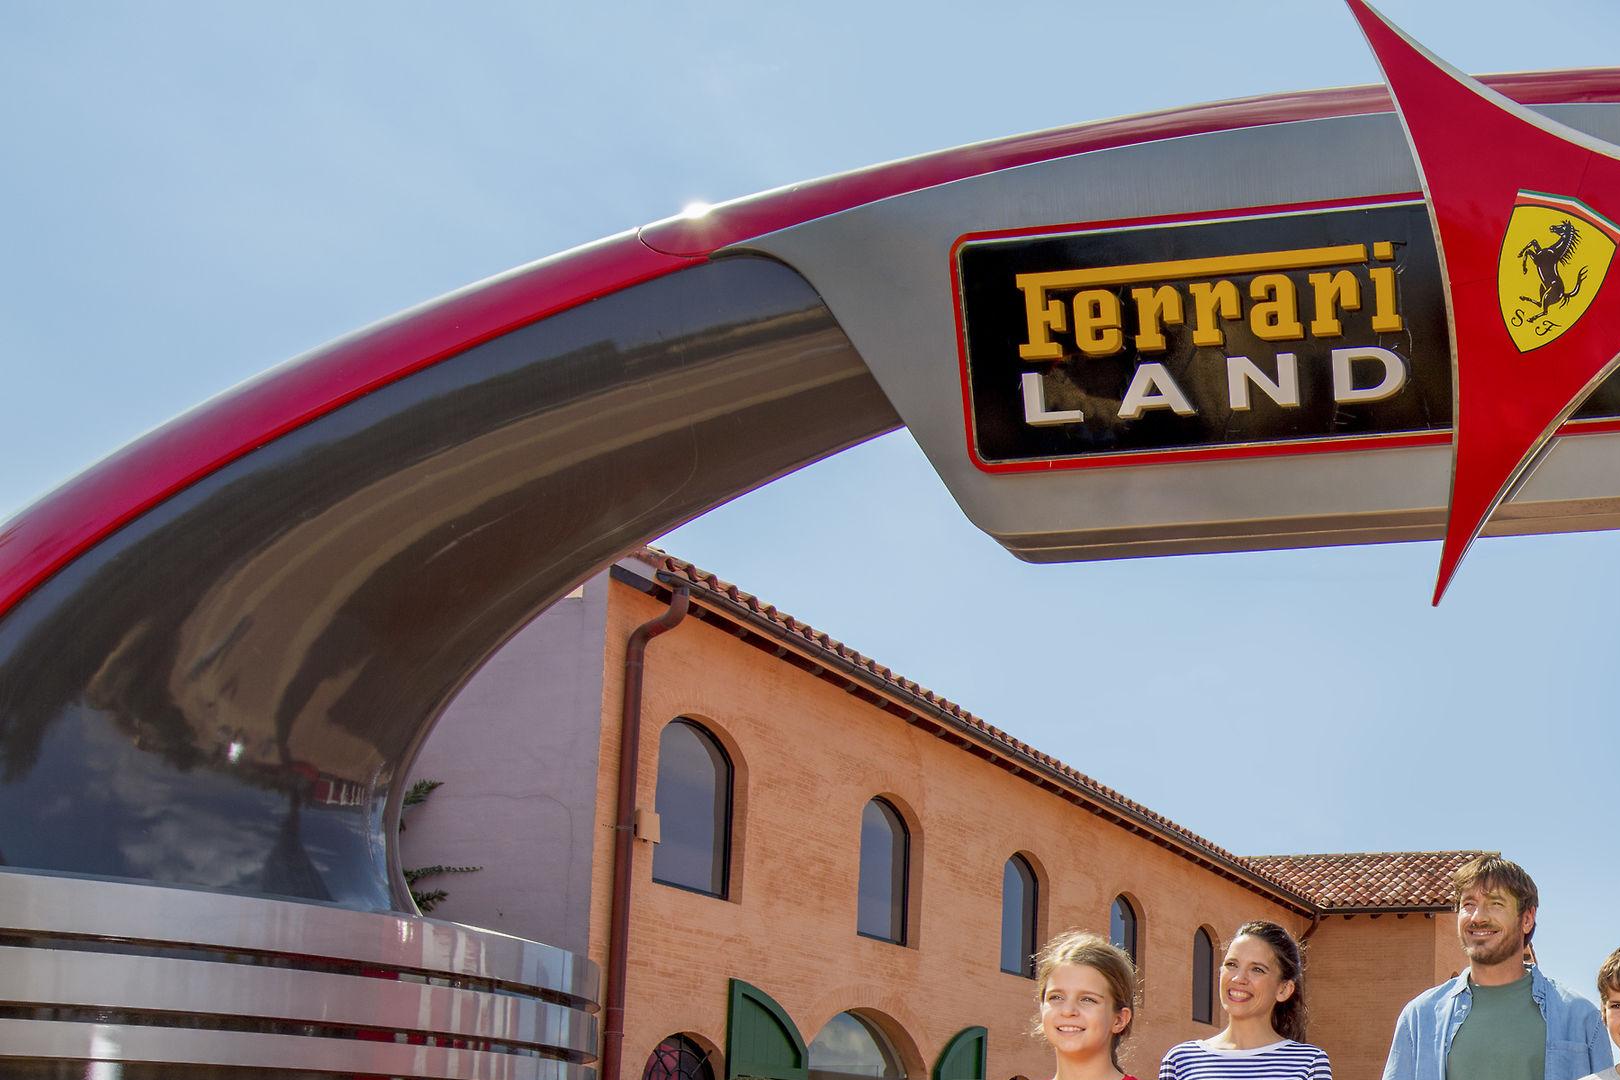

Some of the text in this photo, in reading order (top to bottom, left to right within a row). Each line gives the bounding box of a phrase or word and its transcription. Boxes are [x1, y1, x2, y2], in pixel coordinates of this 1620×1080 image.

[1016, 241, 1402, 360] Ferrari
[1511, 309, 1525, 327] S
[1020, 345, 1407, 426] LAND
